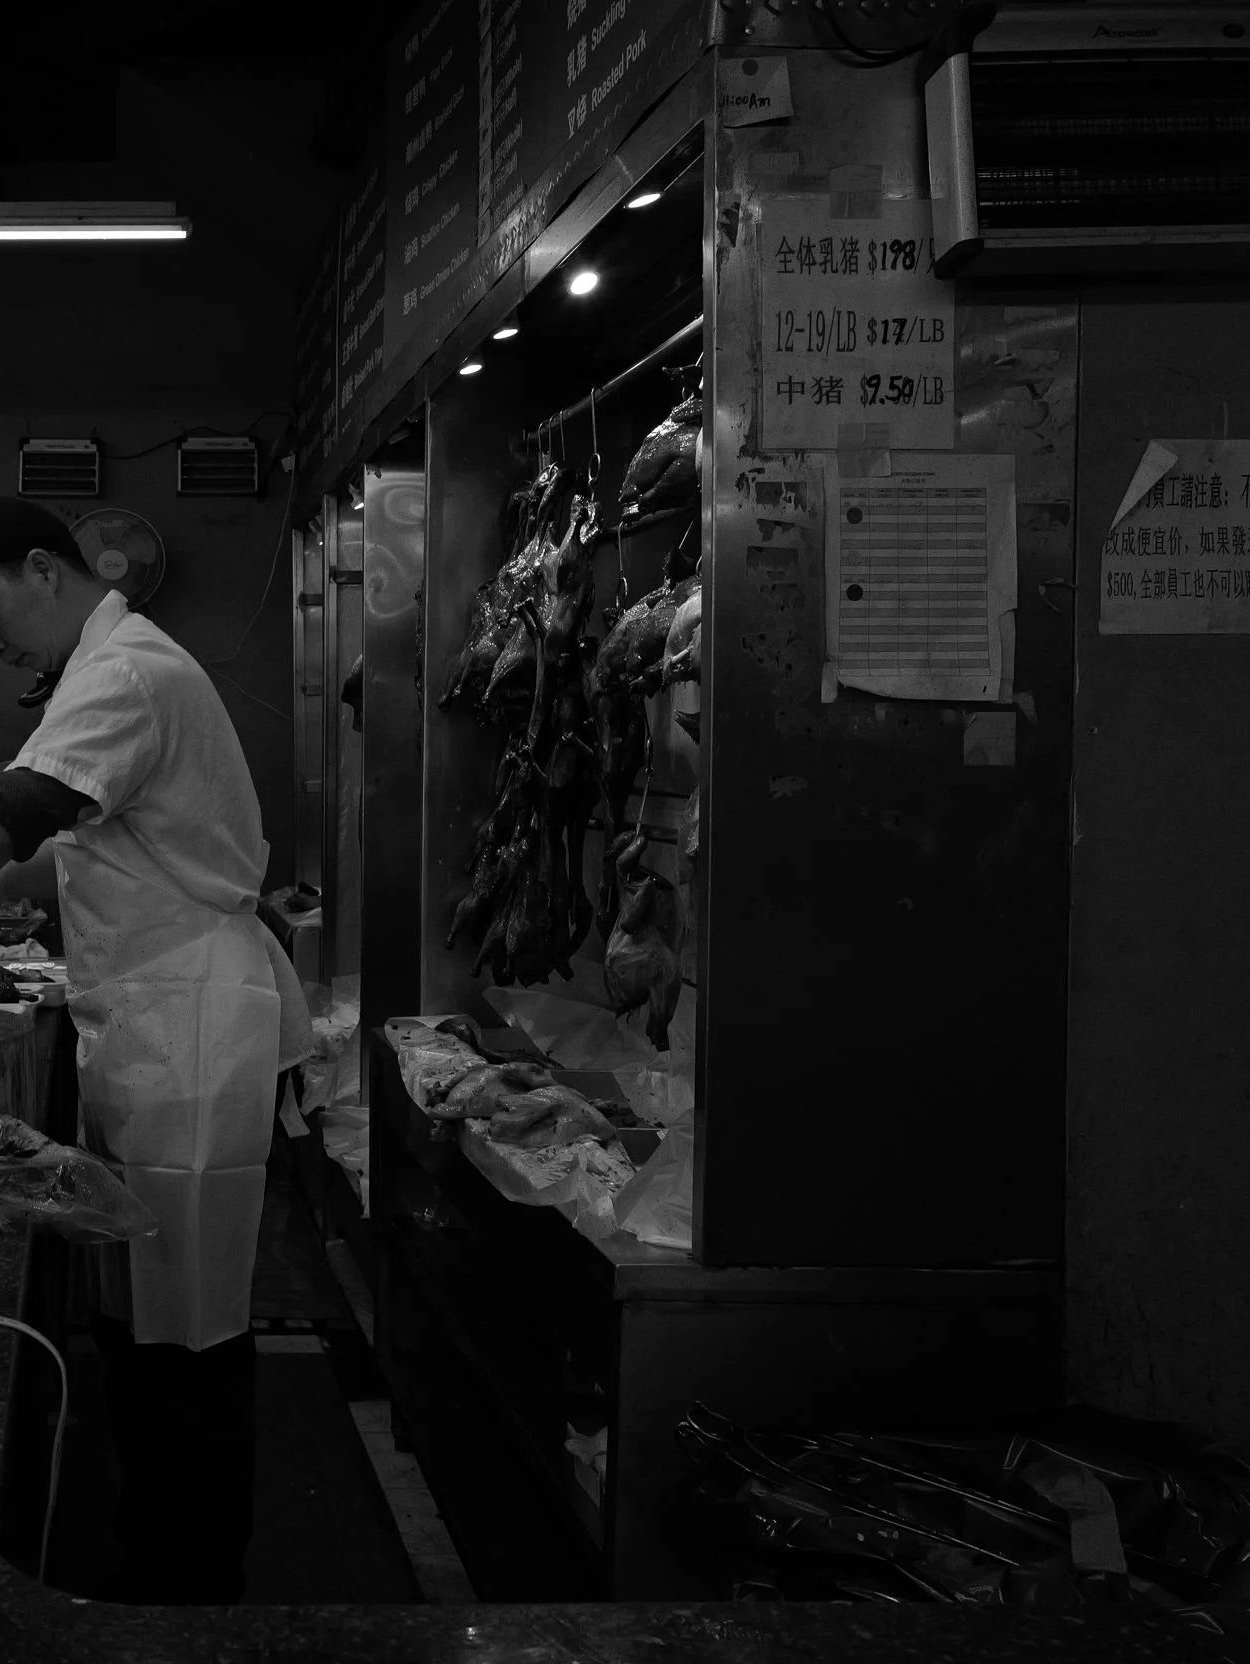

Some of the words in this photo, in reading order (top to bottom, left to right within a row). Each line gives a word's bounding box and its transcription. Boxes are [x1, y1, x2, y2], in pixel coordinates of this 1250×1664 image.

[591, 53, 625, 111] Roasted
[626, 29, 647, 69] Pork
[775, 305, 857, 356] 12-19/LB
